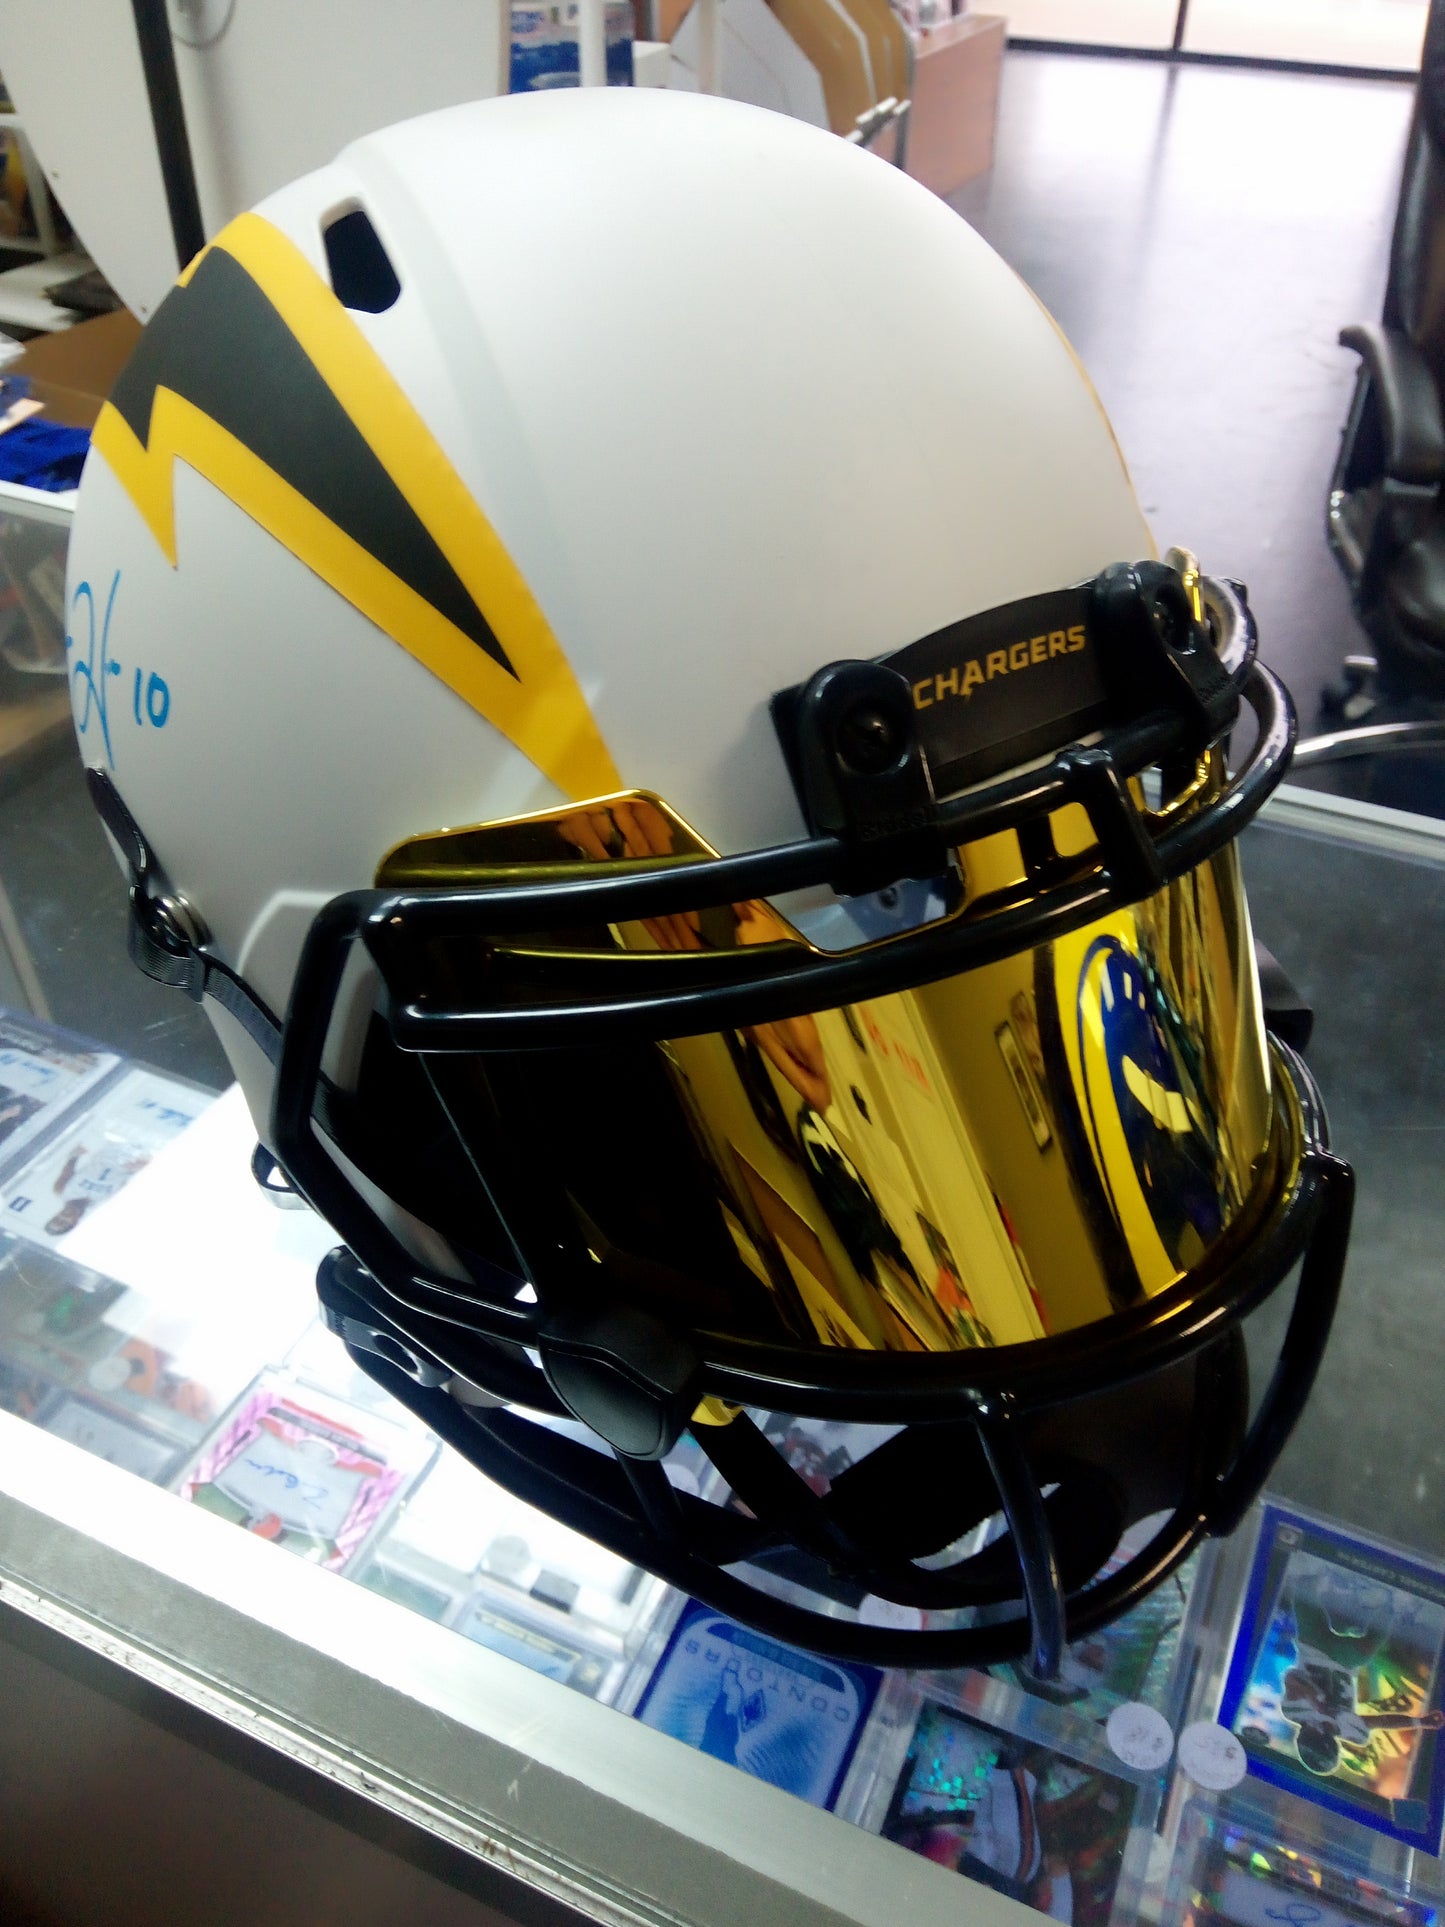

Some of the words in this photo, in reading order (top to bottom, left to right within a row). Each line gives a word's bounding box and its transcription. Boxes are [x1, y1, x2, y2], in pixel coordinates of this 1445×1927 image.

[134, 667, 171, 728] 10
[912, 625, 1086, 710] CHARGERS
[685, 1639, 850, 1723] CONTOURS
